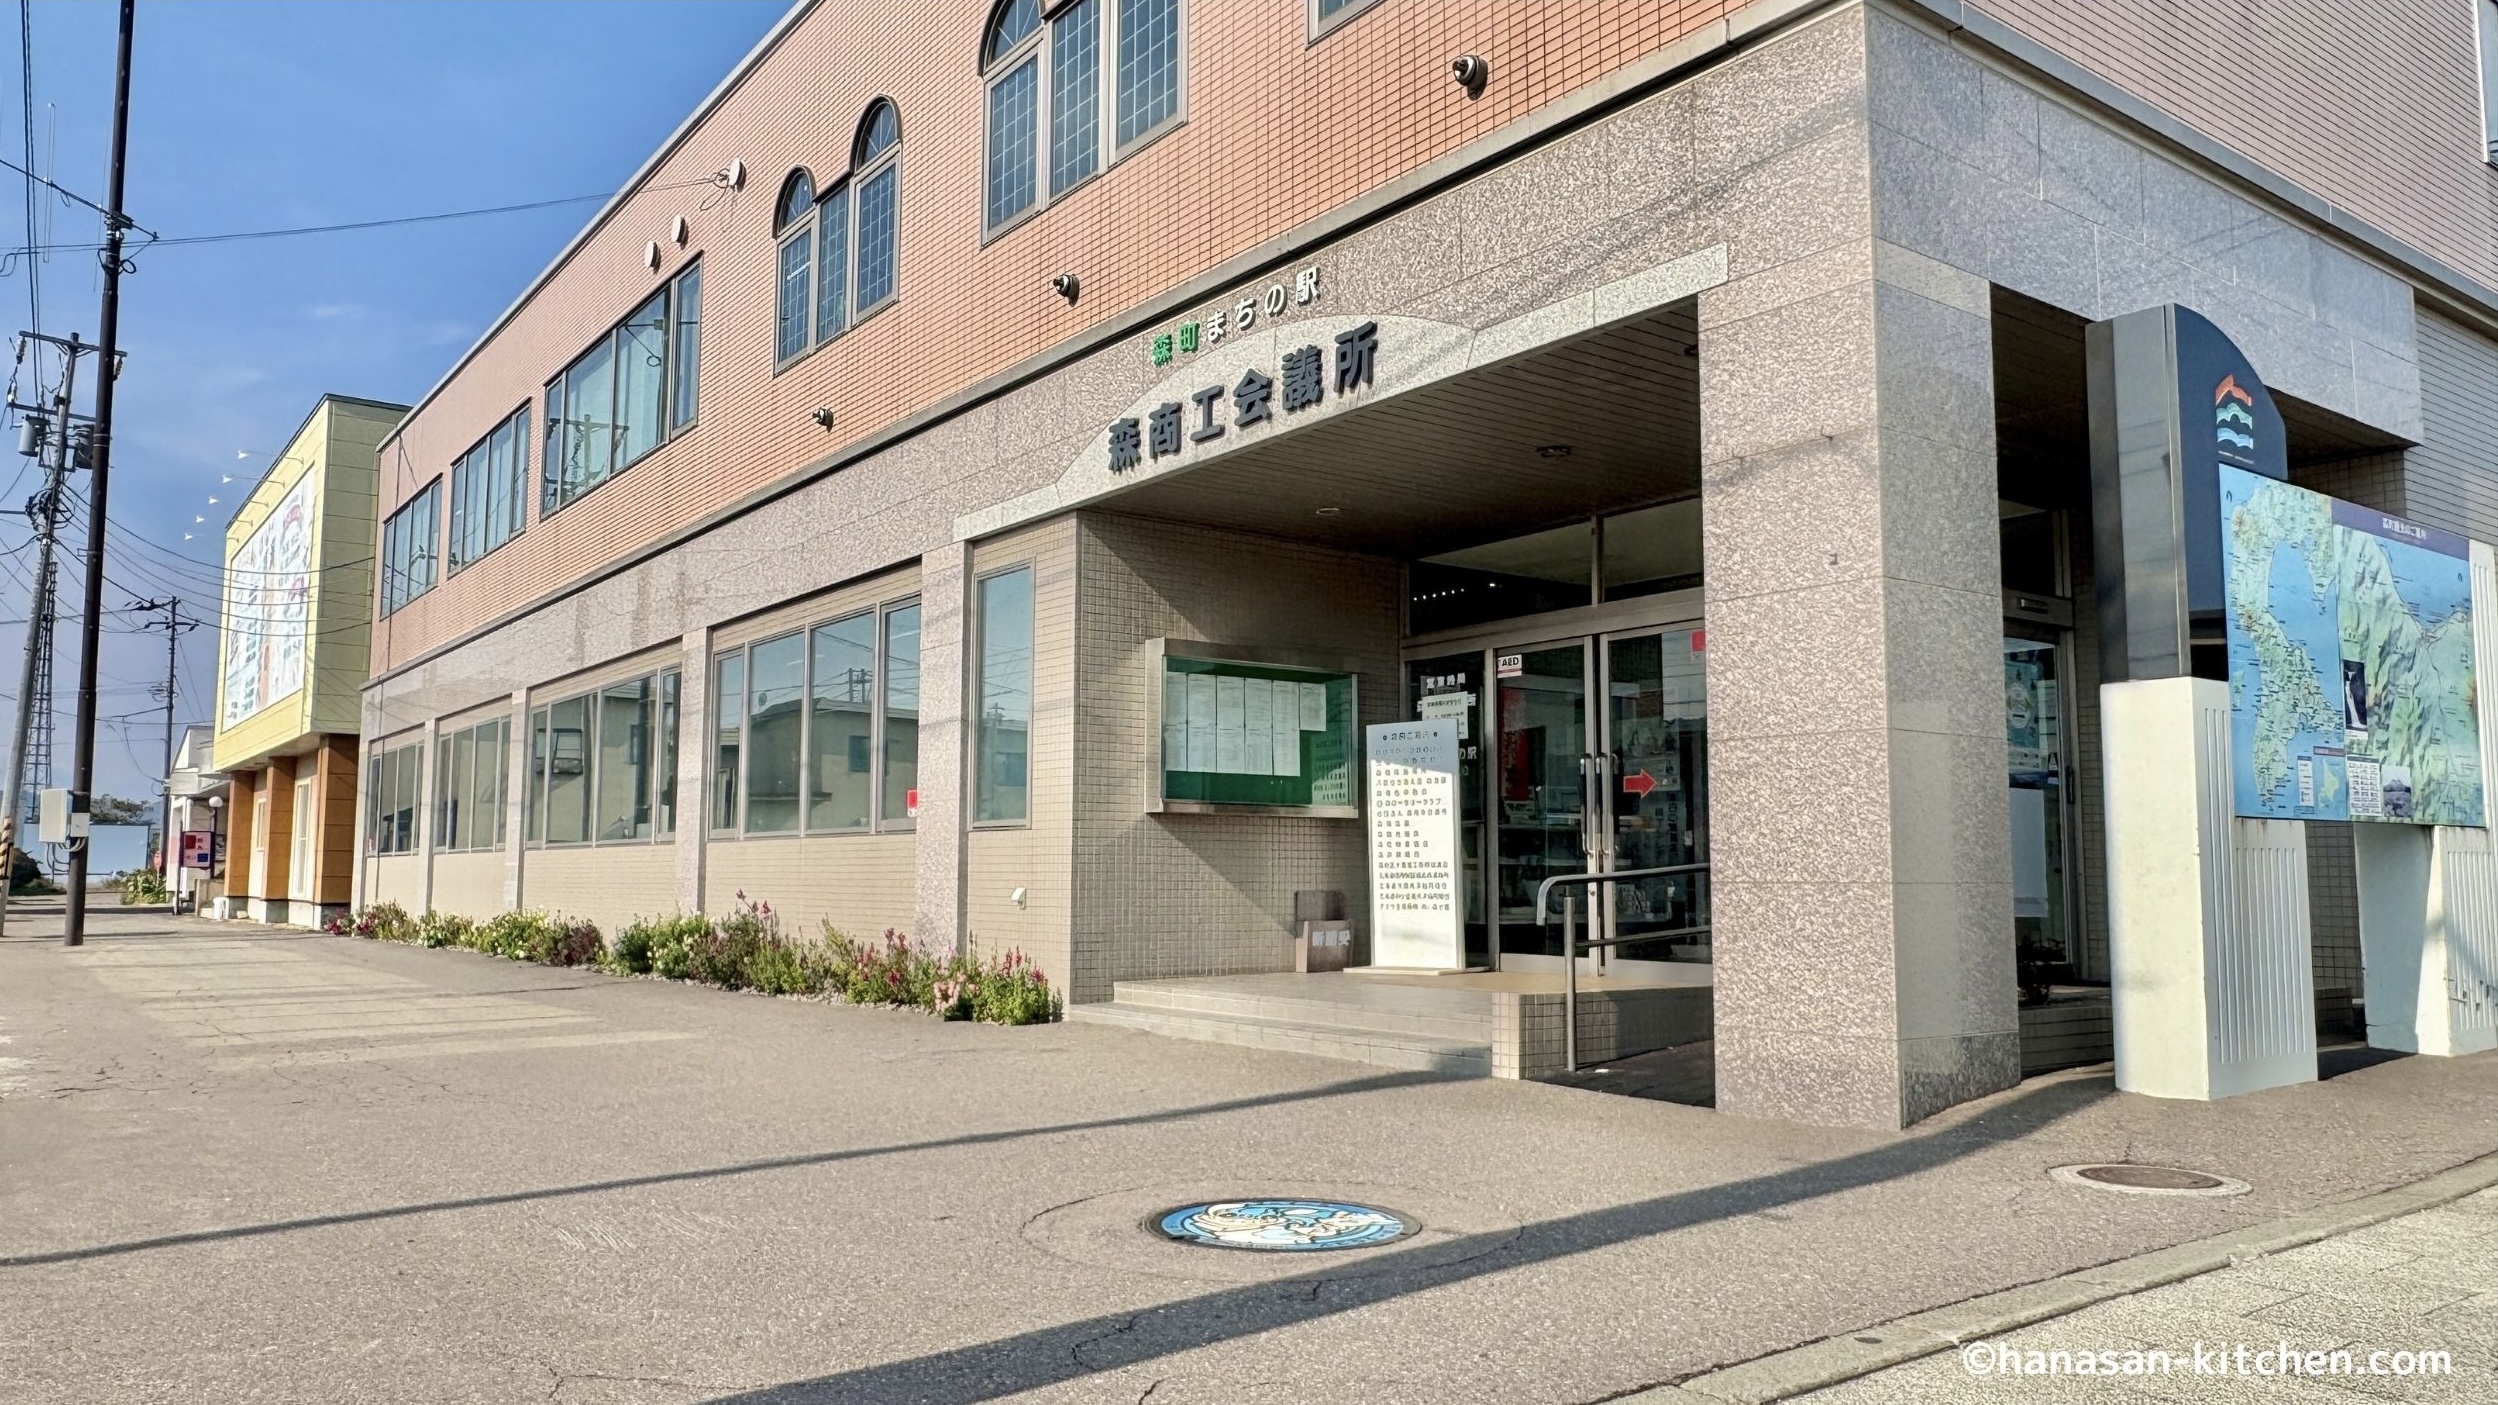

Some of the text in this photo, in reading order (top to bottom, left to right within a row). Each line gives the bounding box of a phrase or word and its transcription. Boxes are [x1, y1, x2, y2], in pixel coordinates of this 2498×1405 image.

[1153, 266, 1322, 366] 森町まちの駅
[1108, 321, 1379, 473] 森商工会議所
[1501, 657, 1520, 667] AED
